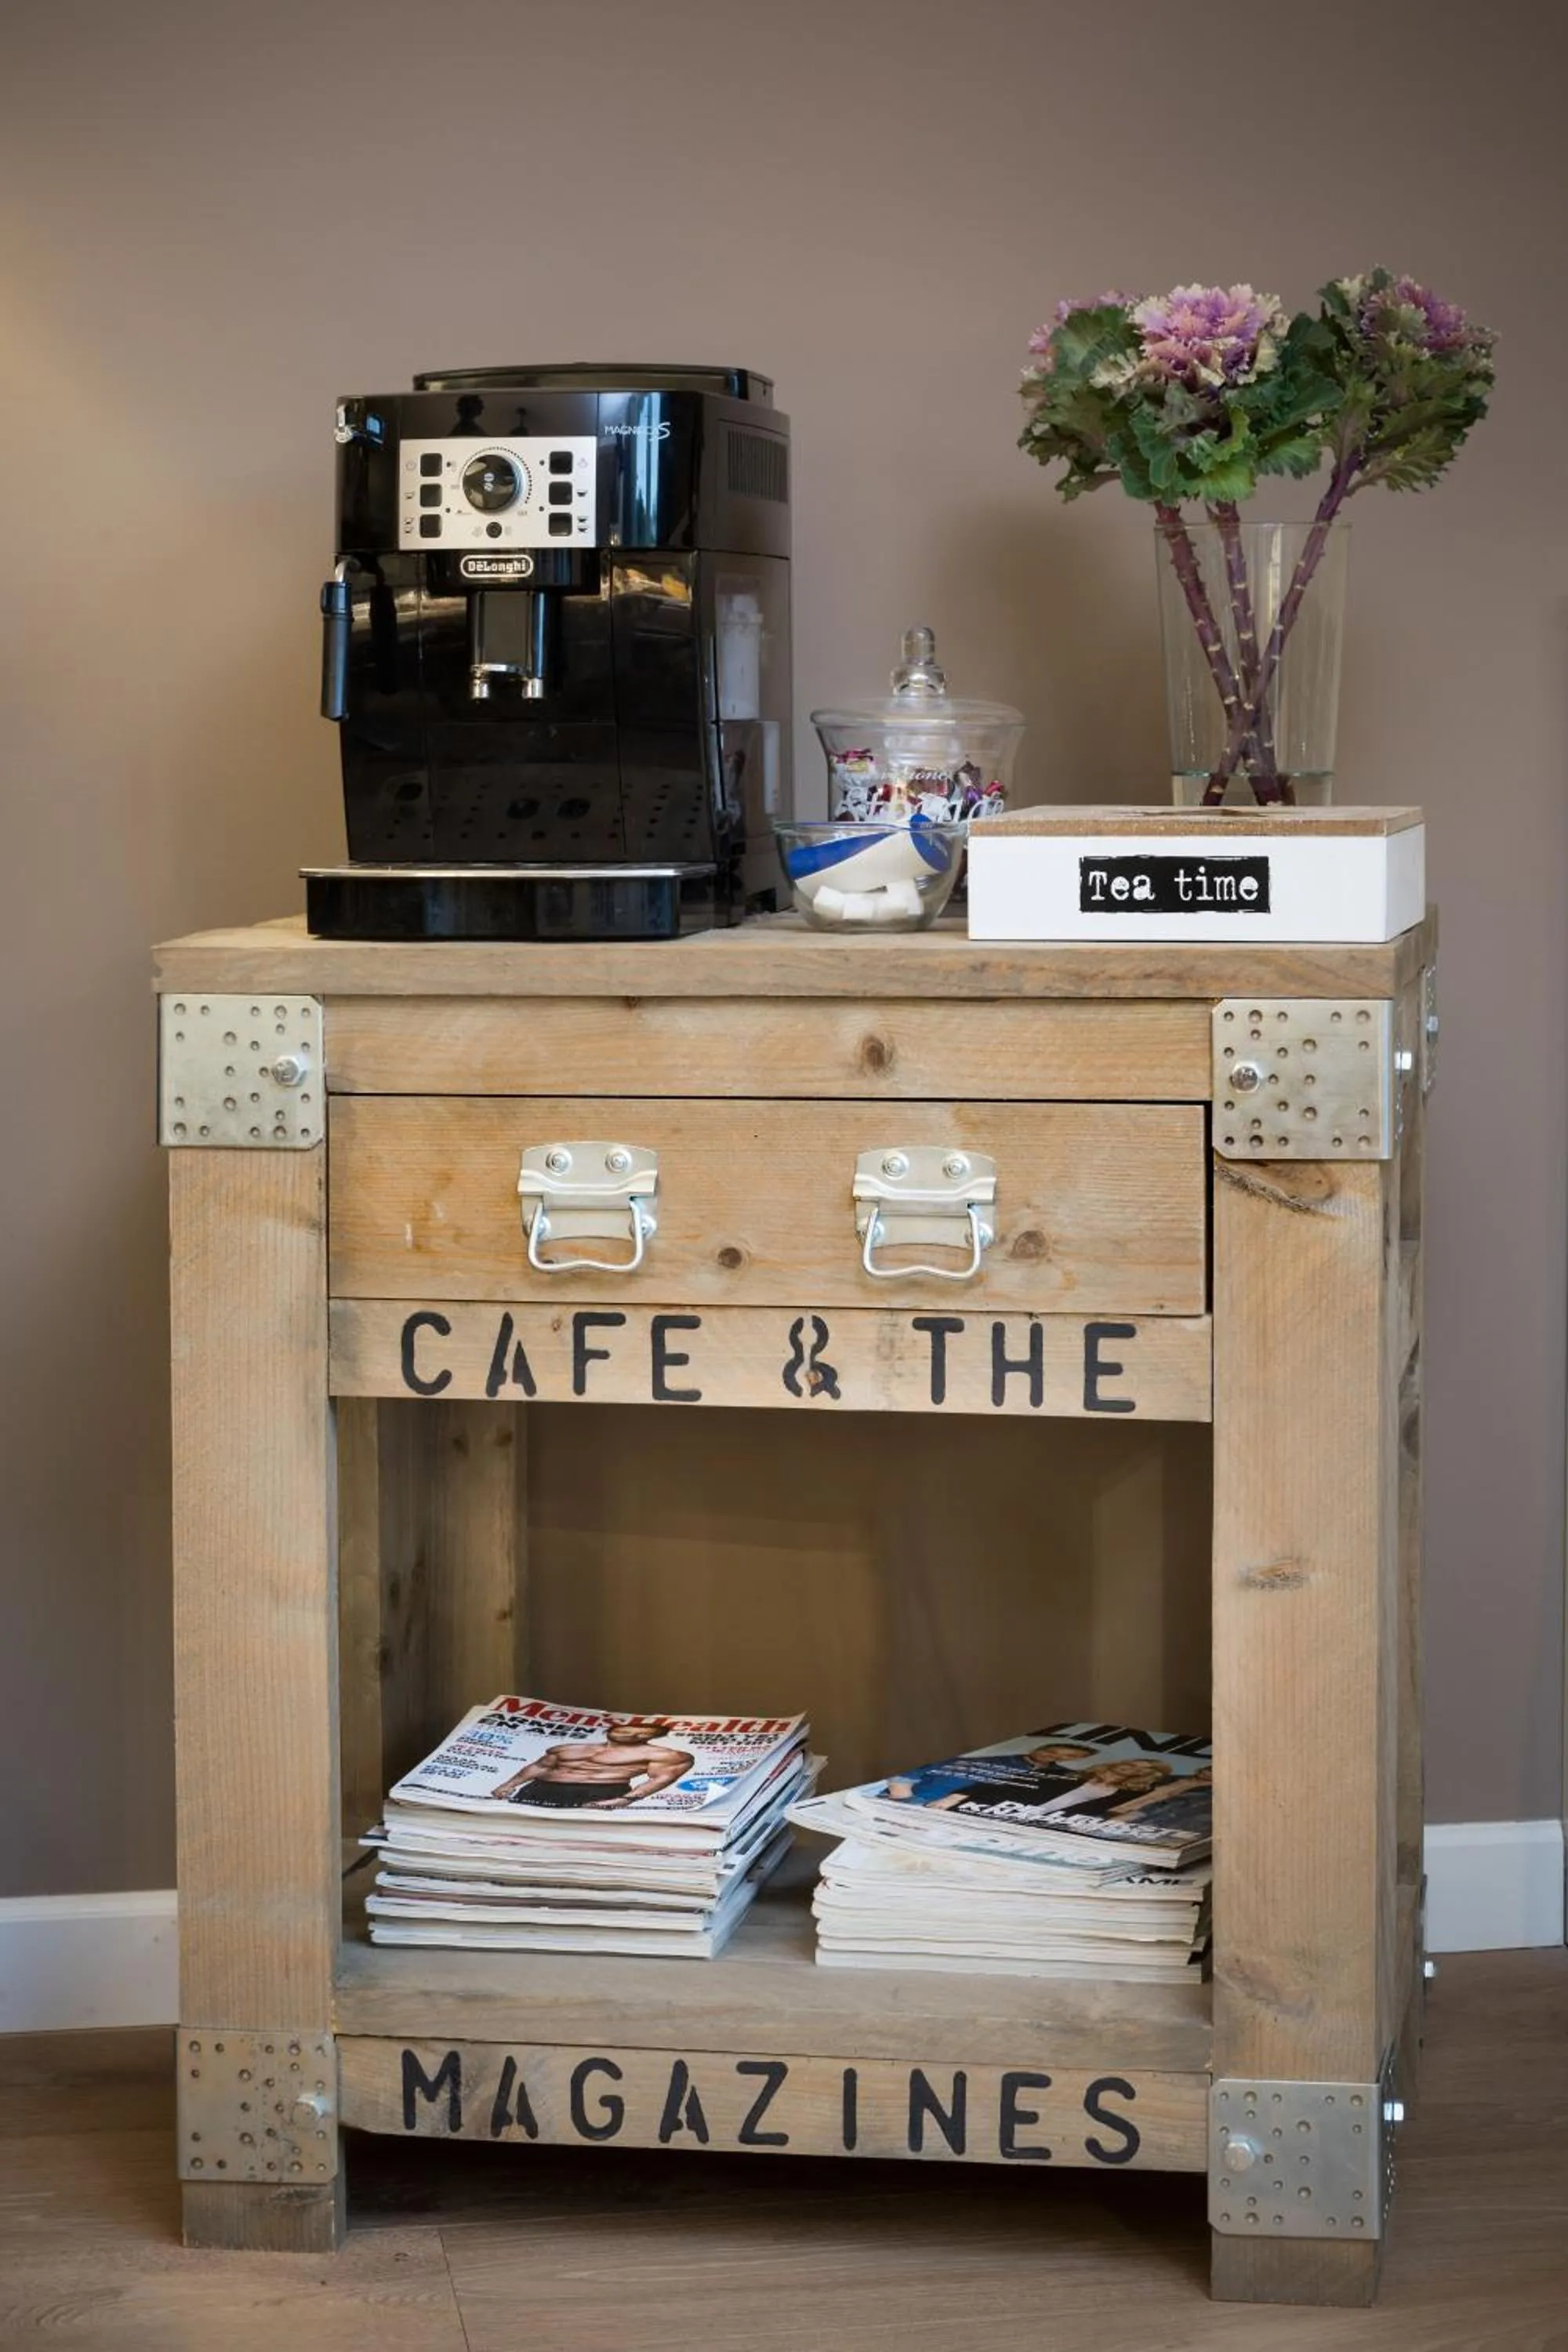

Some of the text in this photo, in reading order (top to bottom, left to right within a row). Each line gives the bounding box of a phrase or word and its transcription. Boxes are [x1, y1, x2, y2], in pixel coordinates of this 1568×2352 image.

[1088, 866, 1259, 901] Tea time
[401, 1312, 1136, 1413] CAFE & THE
[492, 1697, 627, 1728] Men's
[401, 2049, 1141, 2165] MAGAZINES
